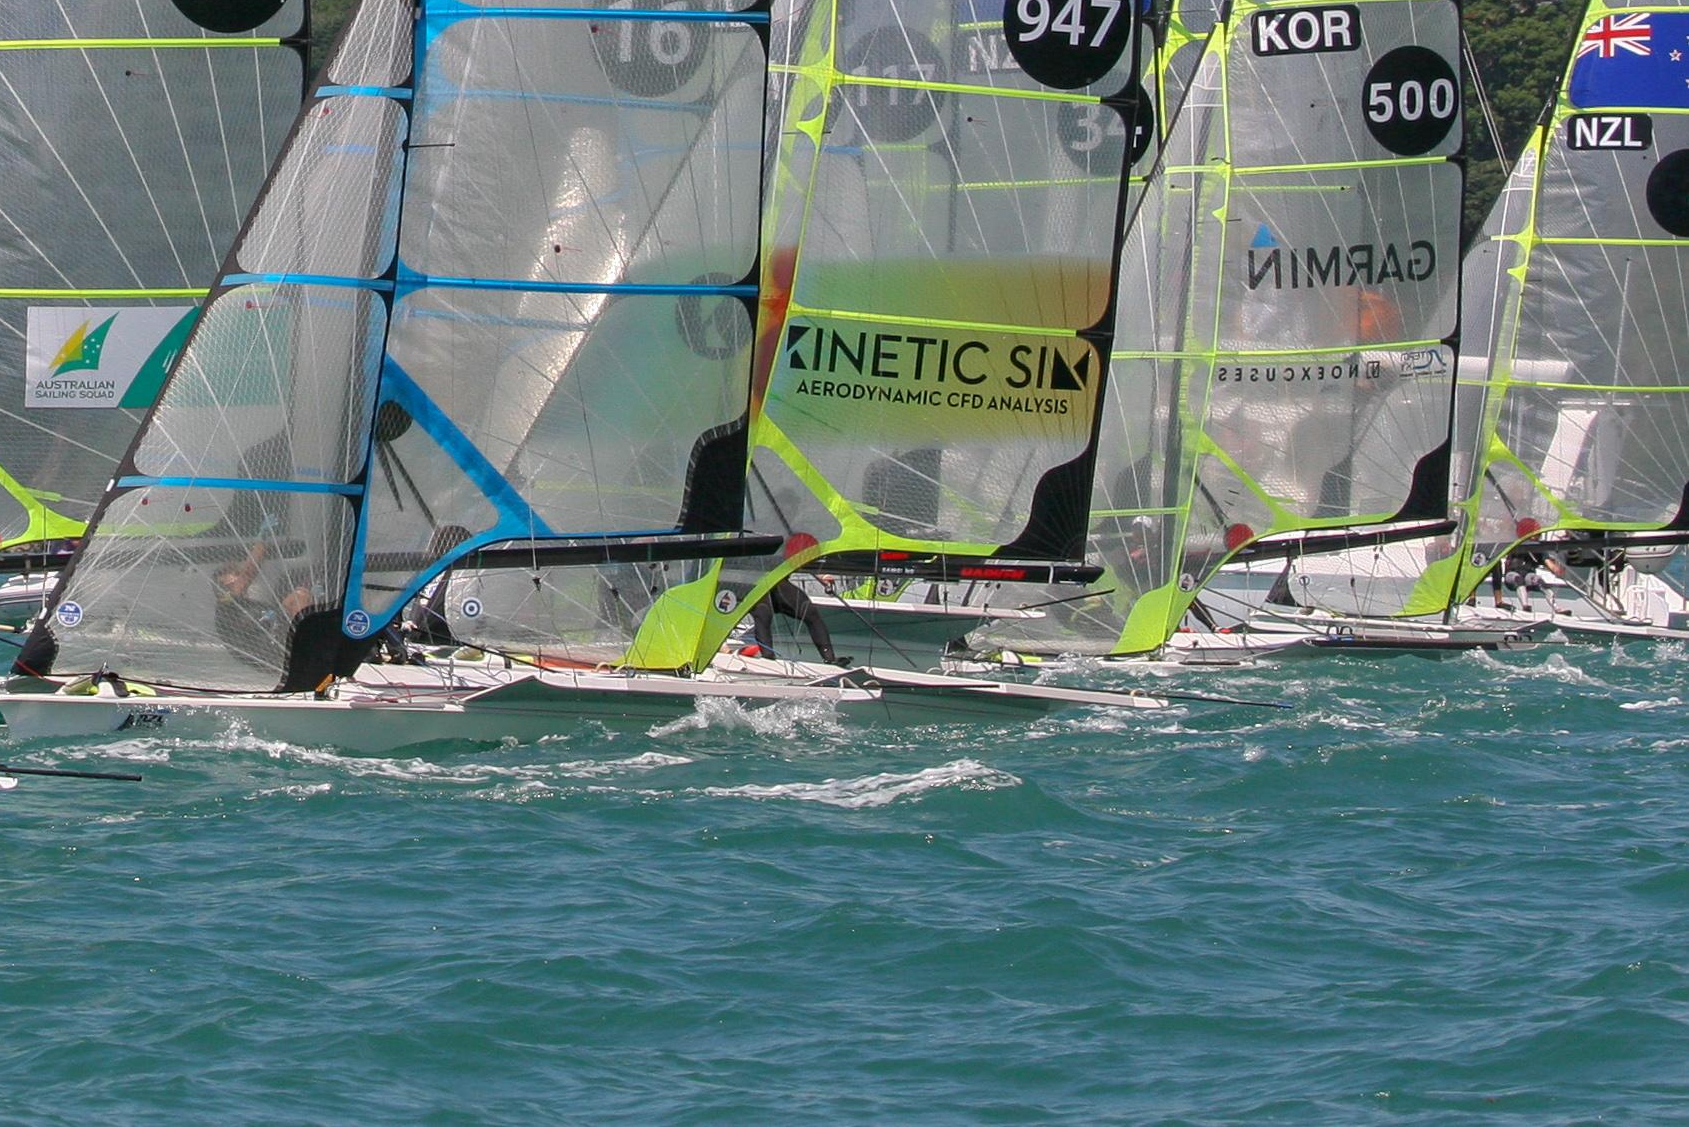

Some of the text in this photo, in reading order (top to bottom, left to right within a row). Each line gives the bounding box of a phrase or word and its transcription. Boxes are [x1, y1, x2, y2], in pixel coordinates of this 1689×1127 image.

[1257, 10, 1352, 53] KOR
[1368, 78, 1454, 123] 500
[1575, 116, 1643, 148] NZL
[786, 325, 991, 386] KINETIC
[35, 390, 115, 399] SAILING SQUAD
[36, 380, 115, 390] AUSTRALIAN
[796, 378, 1069, 415] AERODYNAMIC CFD ANALYSIS
